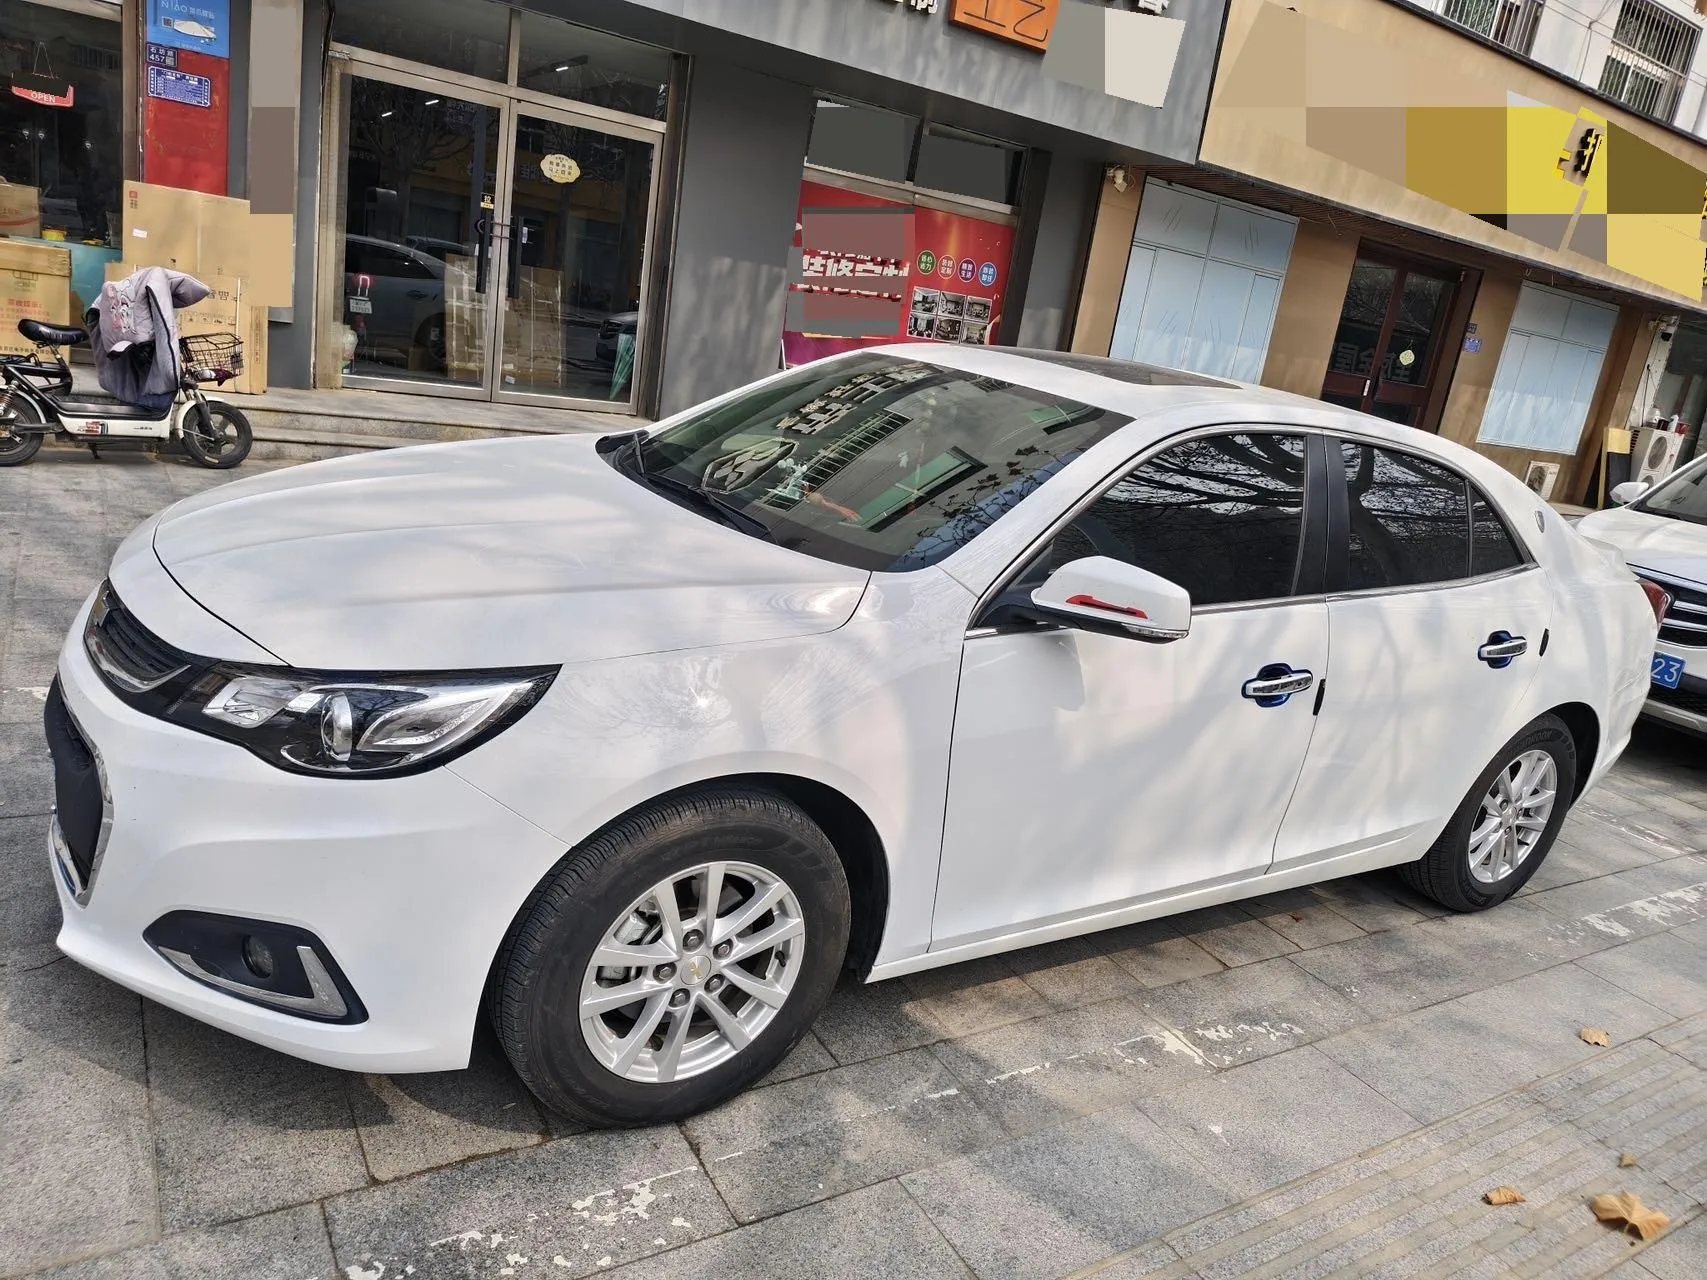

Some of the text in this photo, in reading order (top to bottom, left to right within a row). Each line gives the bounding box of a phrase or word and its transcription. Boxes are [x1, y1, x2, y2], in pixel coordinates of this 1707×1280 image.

[149, 54, 165, 63] 457
[31, 91, 56, 103] OPEN
[1651, 658, 1680, 683] 23
